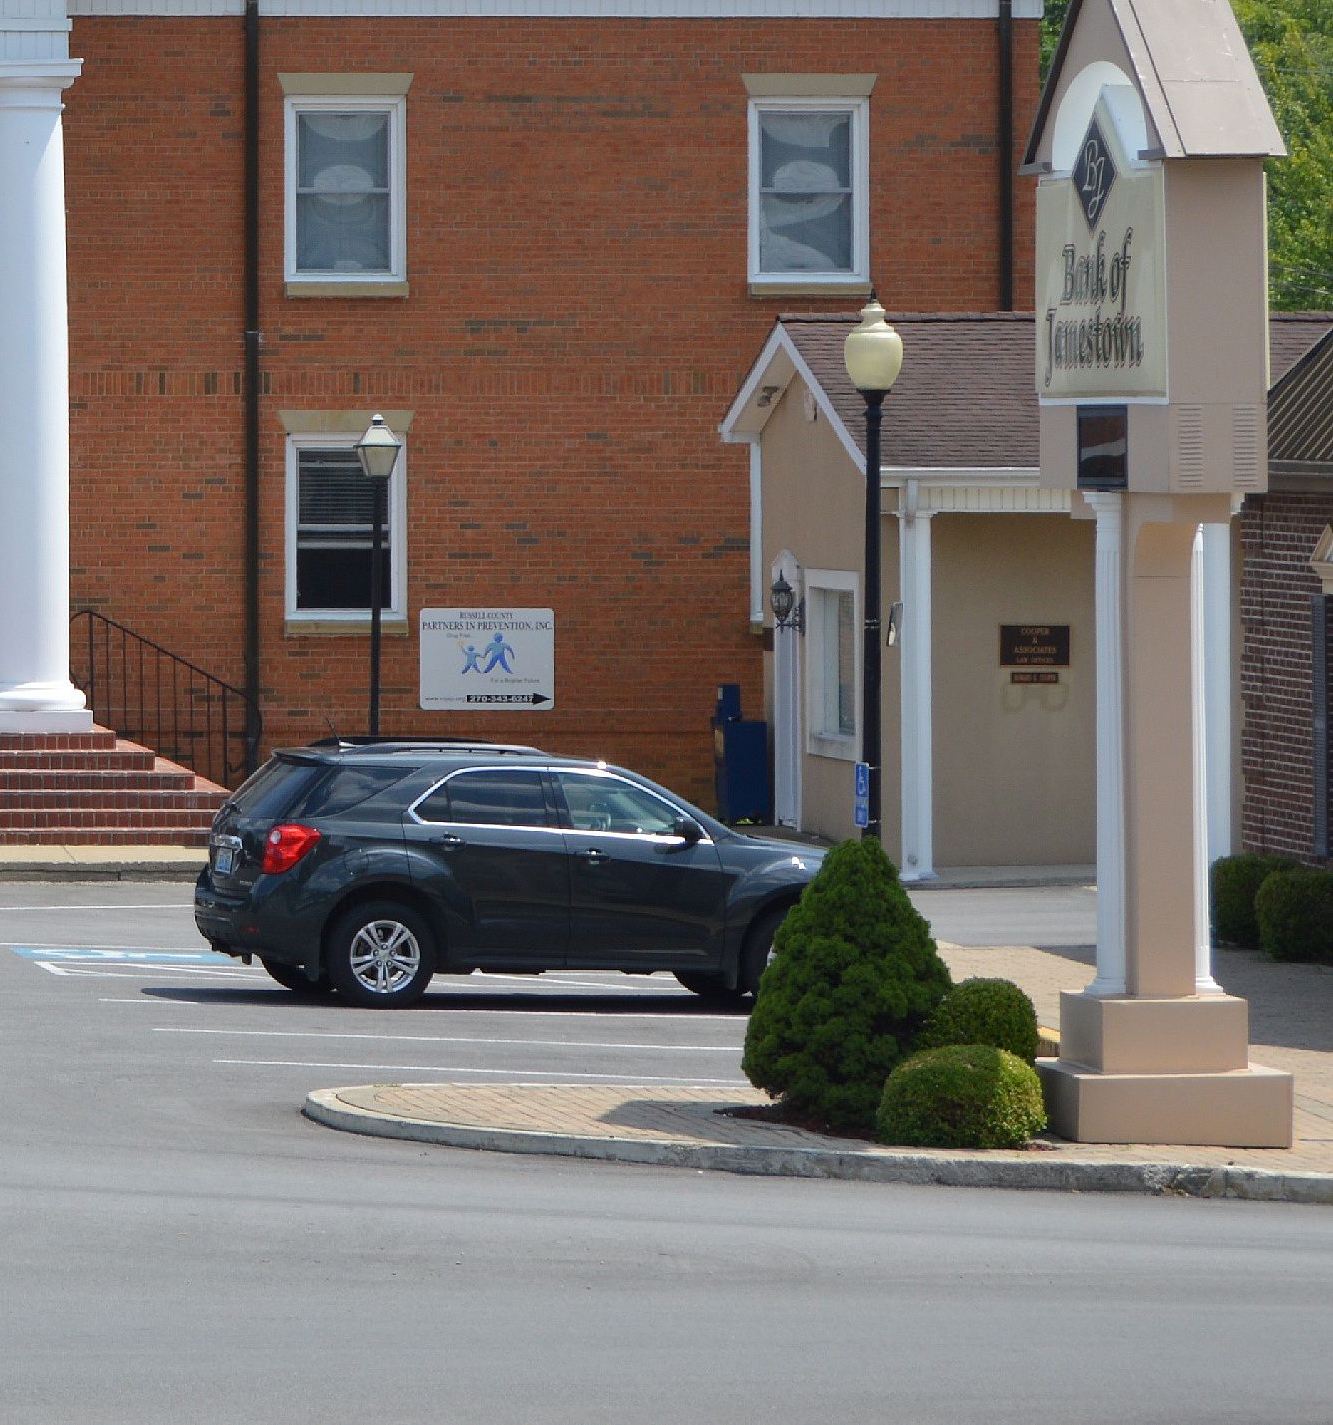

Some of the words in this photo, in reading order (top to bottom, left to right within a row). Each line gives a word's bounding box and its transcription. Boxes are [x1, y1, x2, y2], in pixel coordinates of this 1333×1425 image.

[1060, 230, 1108, 306] Bank
[1109, 226, 1134, 315] of
[1045, 307, 1145, 388] Jamestown
[422, 621, 463, 631] PARTNERS
[466, 621, 475, 631] IN
[478, 621, 534, 631] PREVENTION,
[536, 621, 553, 631] INC.
